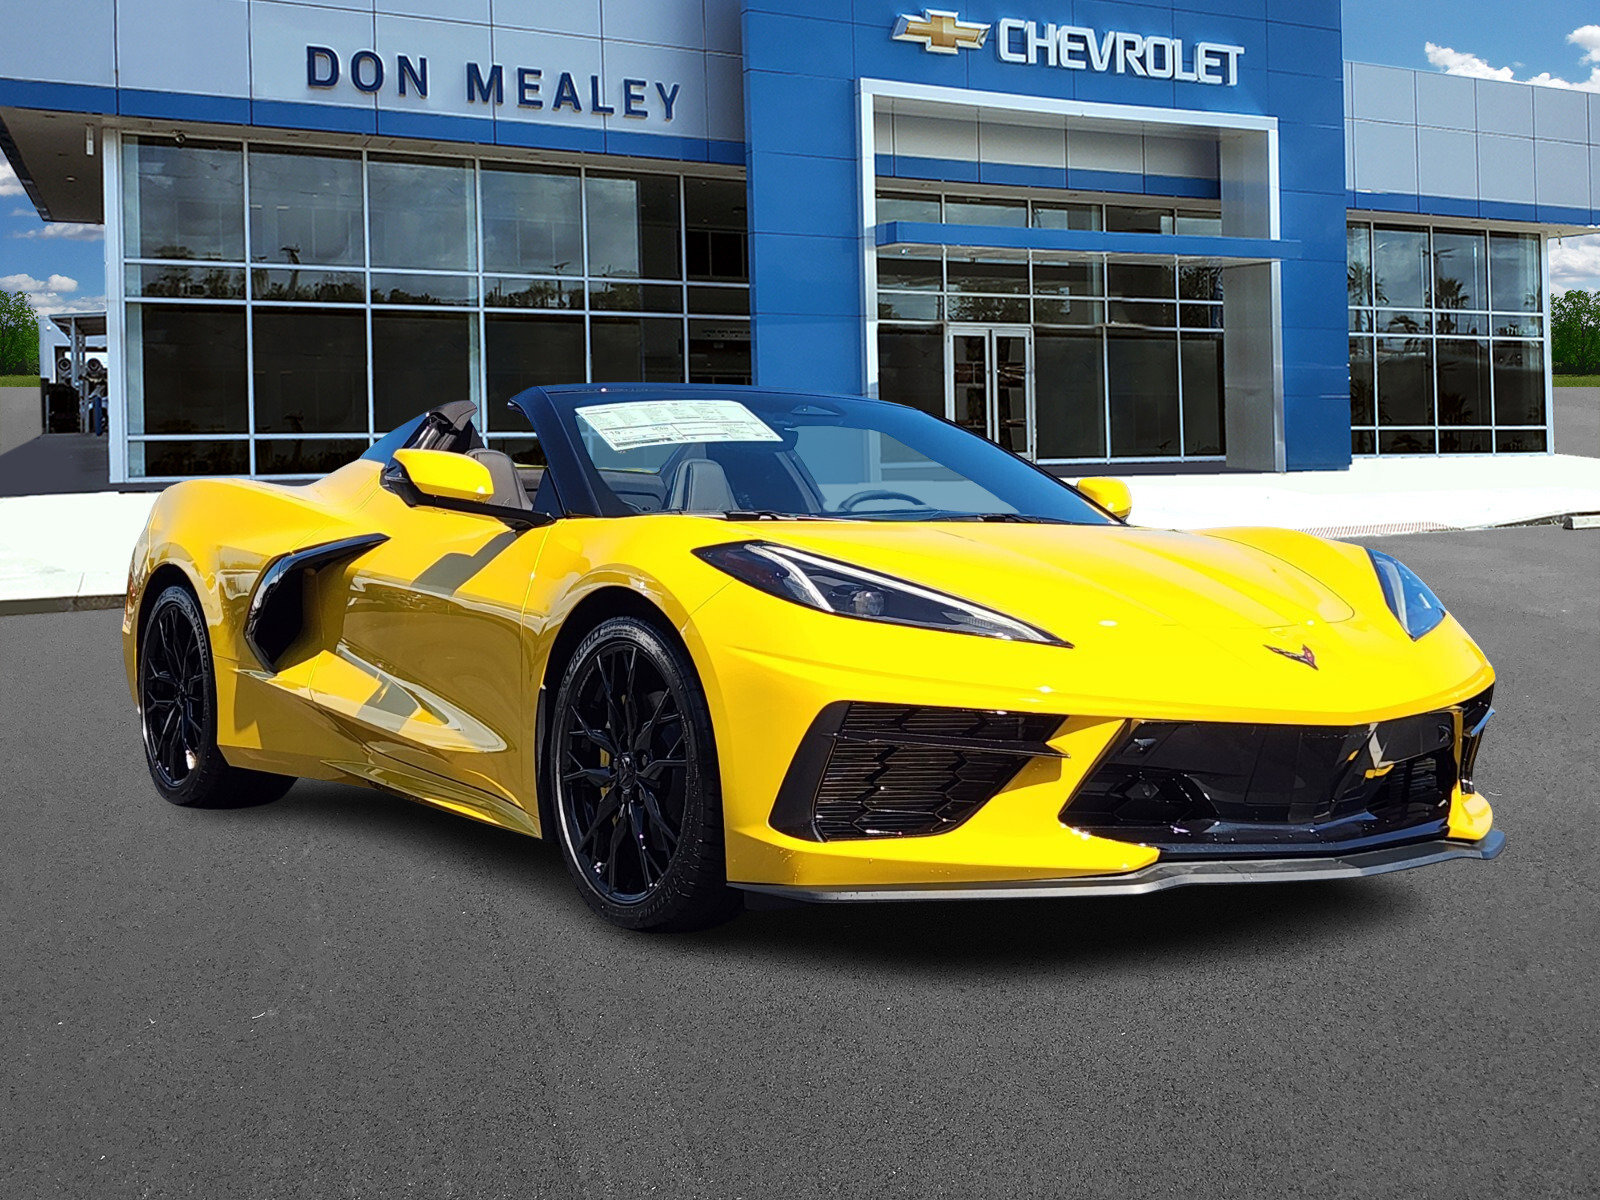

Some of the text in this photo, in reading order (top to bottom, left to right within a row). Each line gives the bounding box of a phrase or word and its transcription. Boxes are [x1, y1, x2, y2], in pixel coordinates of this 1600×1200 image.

[306, 45, 680, 120] DON MEALEY
[998, 17, 1245, 85] CHEVROLET
